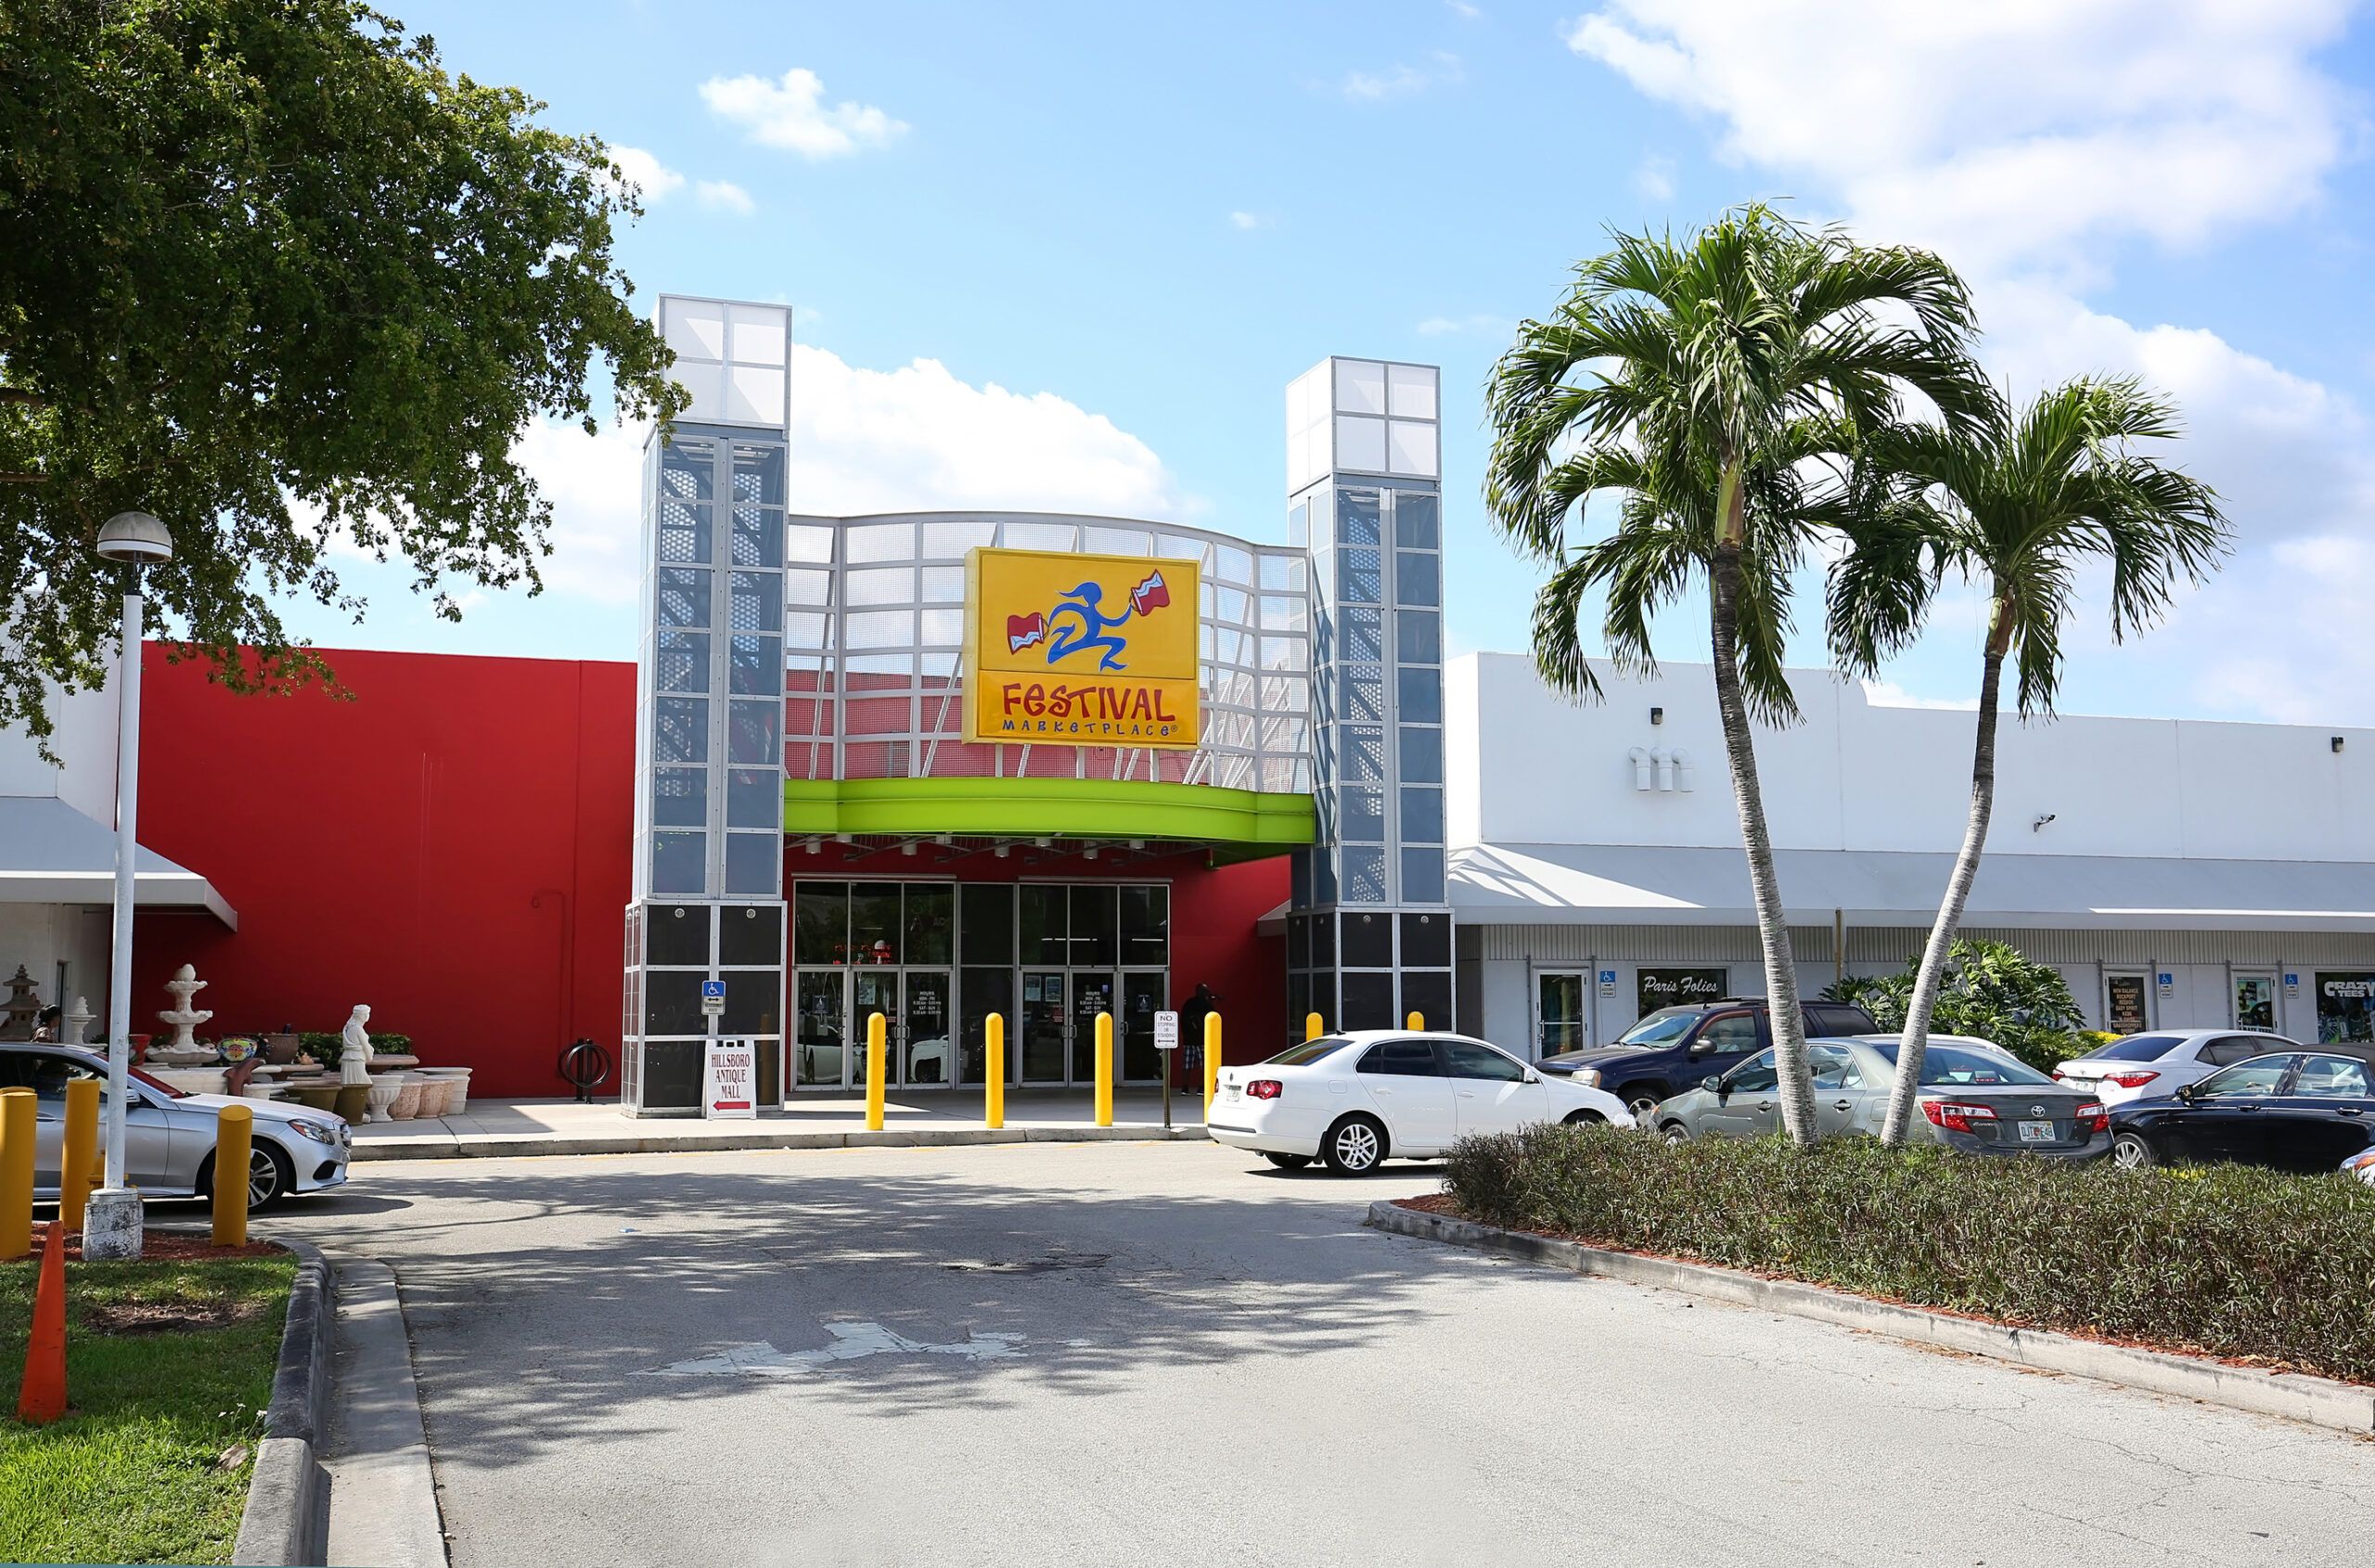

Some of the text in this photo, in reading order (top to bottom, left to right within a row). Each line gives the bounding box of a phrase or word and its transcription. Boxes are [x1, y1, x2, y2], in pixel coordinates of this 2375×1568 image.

[1644, 975, 1718, 995] Paris Folies
[2324, 981, 2375, 997] CRAZY
[2338, 989, 2365, 997] TEES
[711, 1054, 751, 1067] HILLSBORO
[715, 1069, 746, 1084] ANTIQUE
[721, 1086, 741, 1099] MALL
